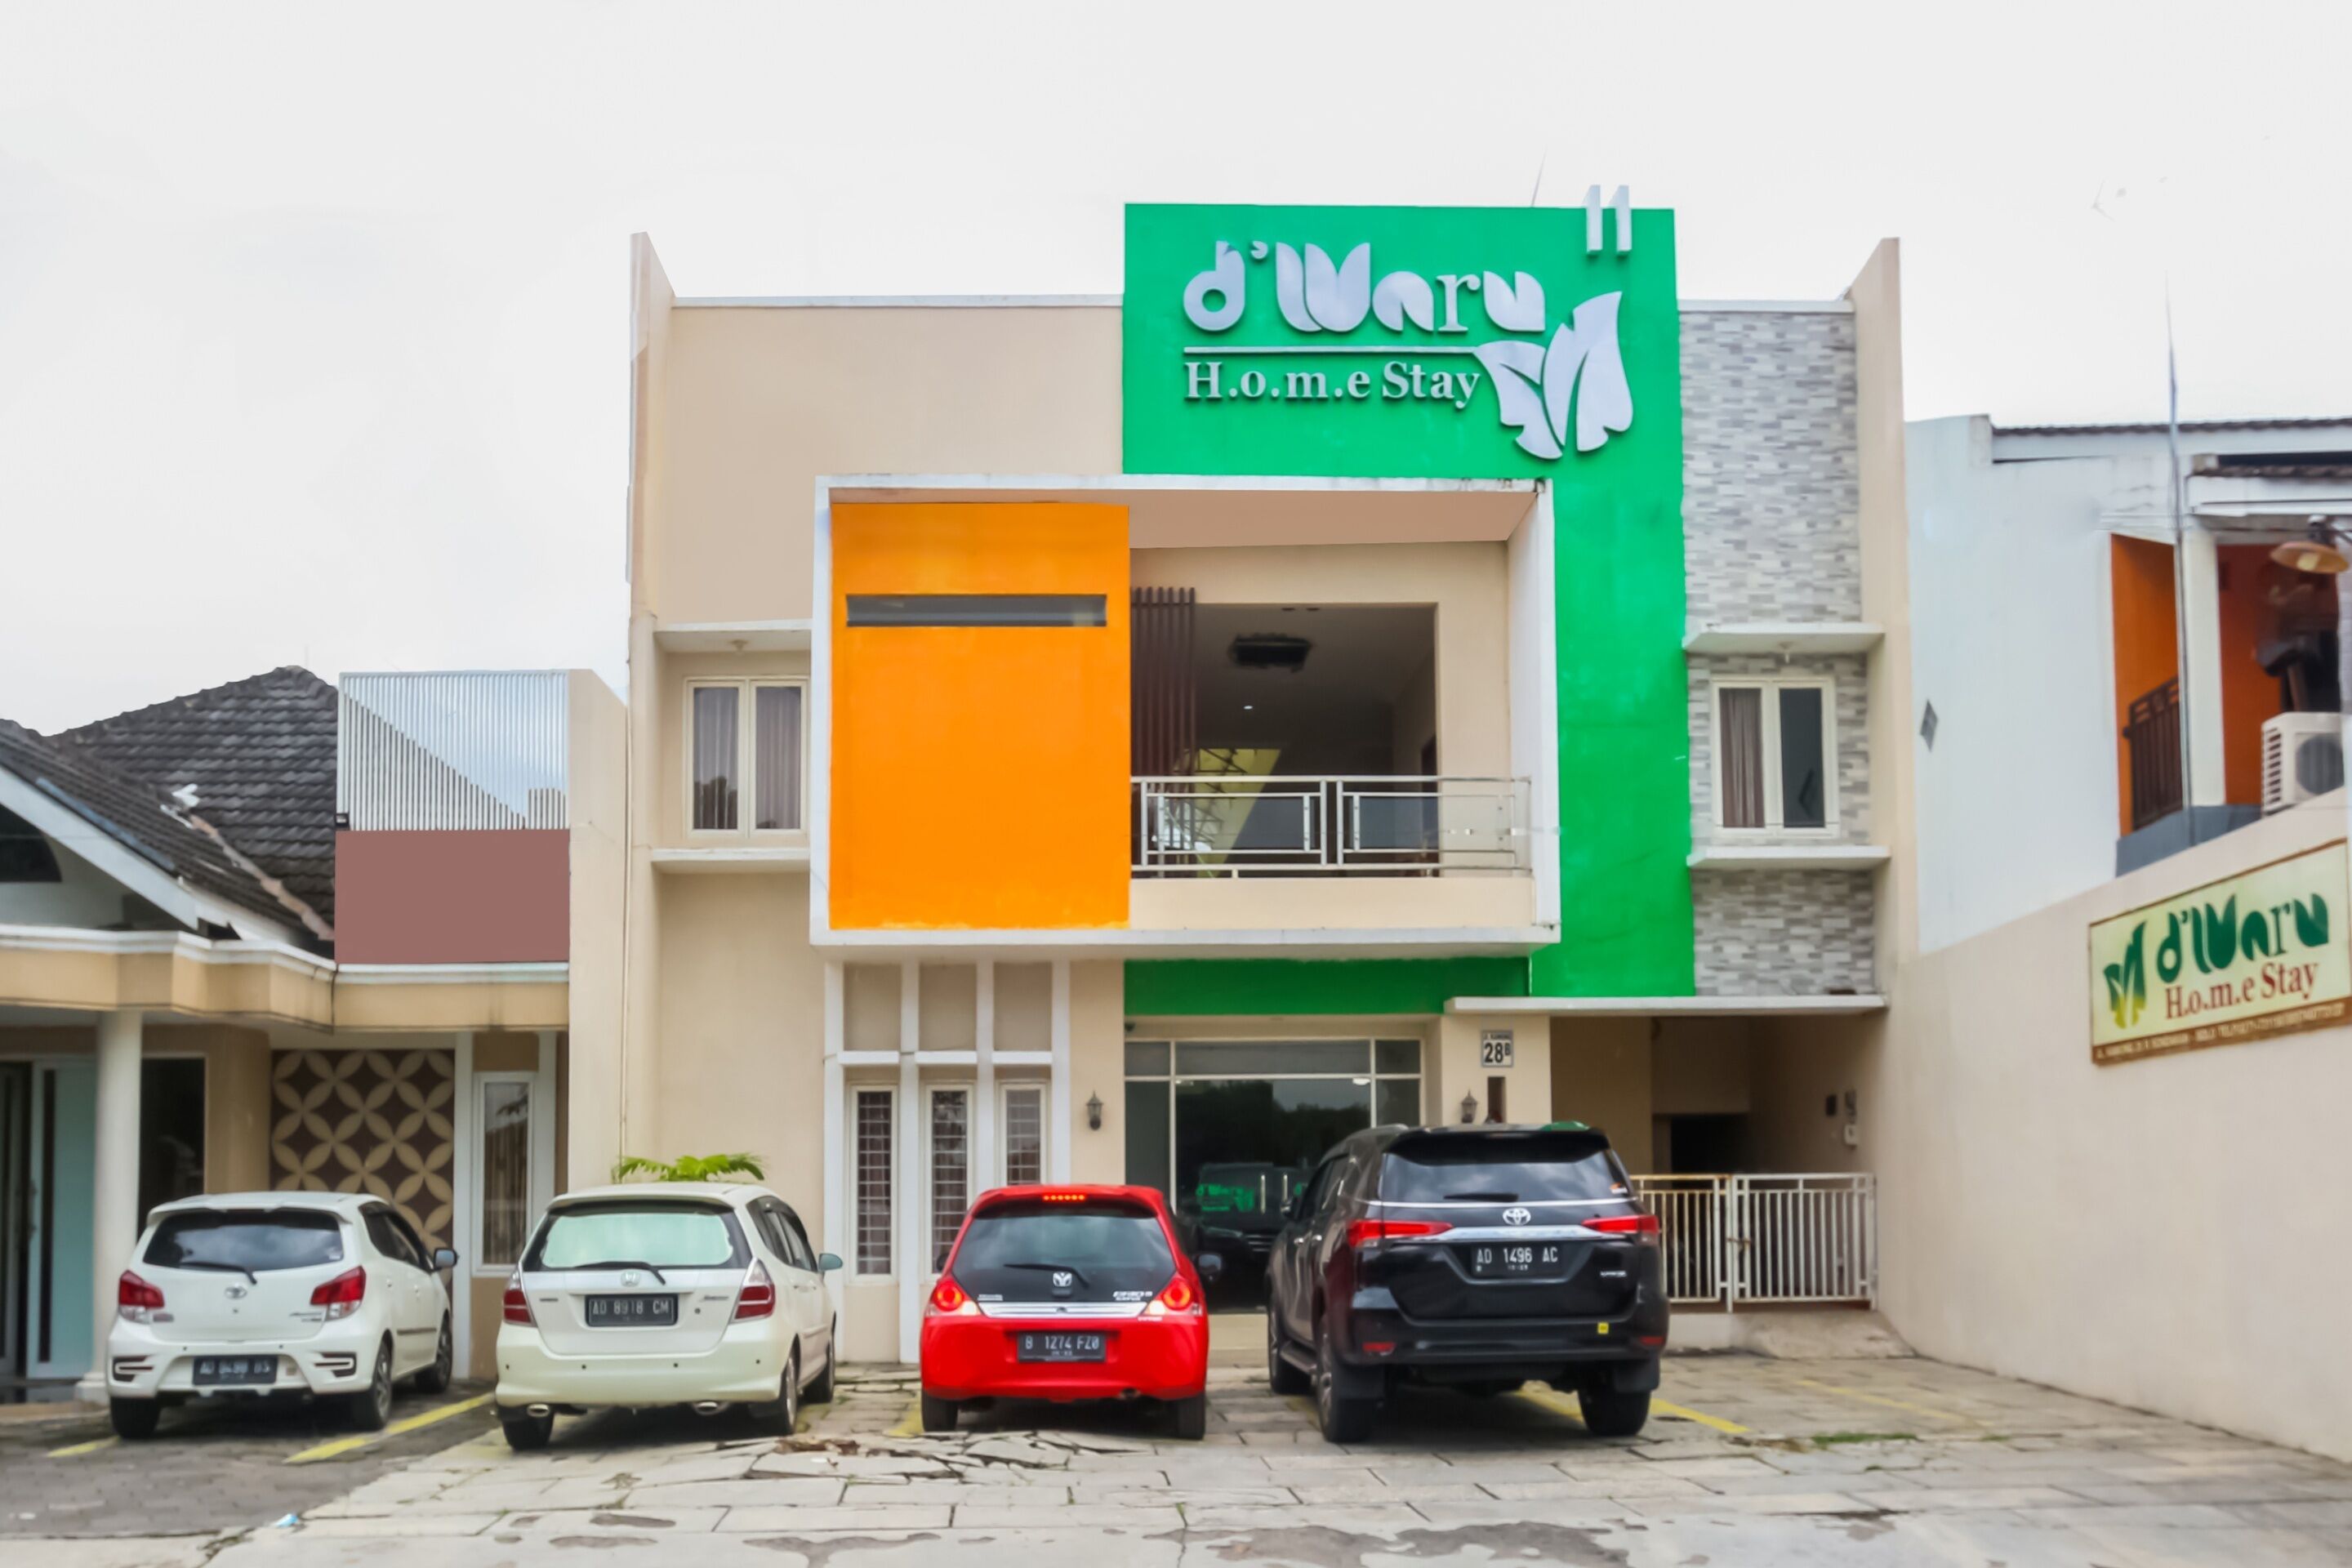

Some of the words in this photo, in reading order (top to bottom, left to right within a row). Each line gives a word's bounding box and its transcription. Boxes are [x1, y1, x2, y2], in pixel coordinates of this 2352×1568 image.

[1183, 240, 1545, 332] d'Waru
[1184, 362, 1370, 398] H.o.m.e
[1382, 361, 1481, 409] Stay
[2157, 893, 2329, 983] d'Waru
[2260, 962, 2319, 1000] Stay
[1477, 1249, 1493, 1264] AD
[1503, 1247, 1533, 1263] 1496
[1543, 1246, 1559, 1263] AC
[653, 1299, 669, 1315] CM
